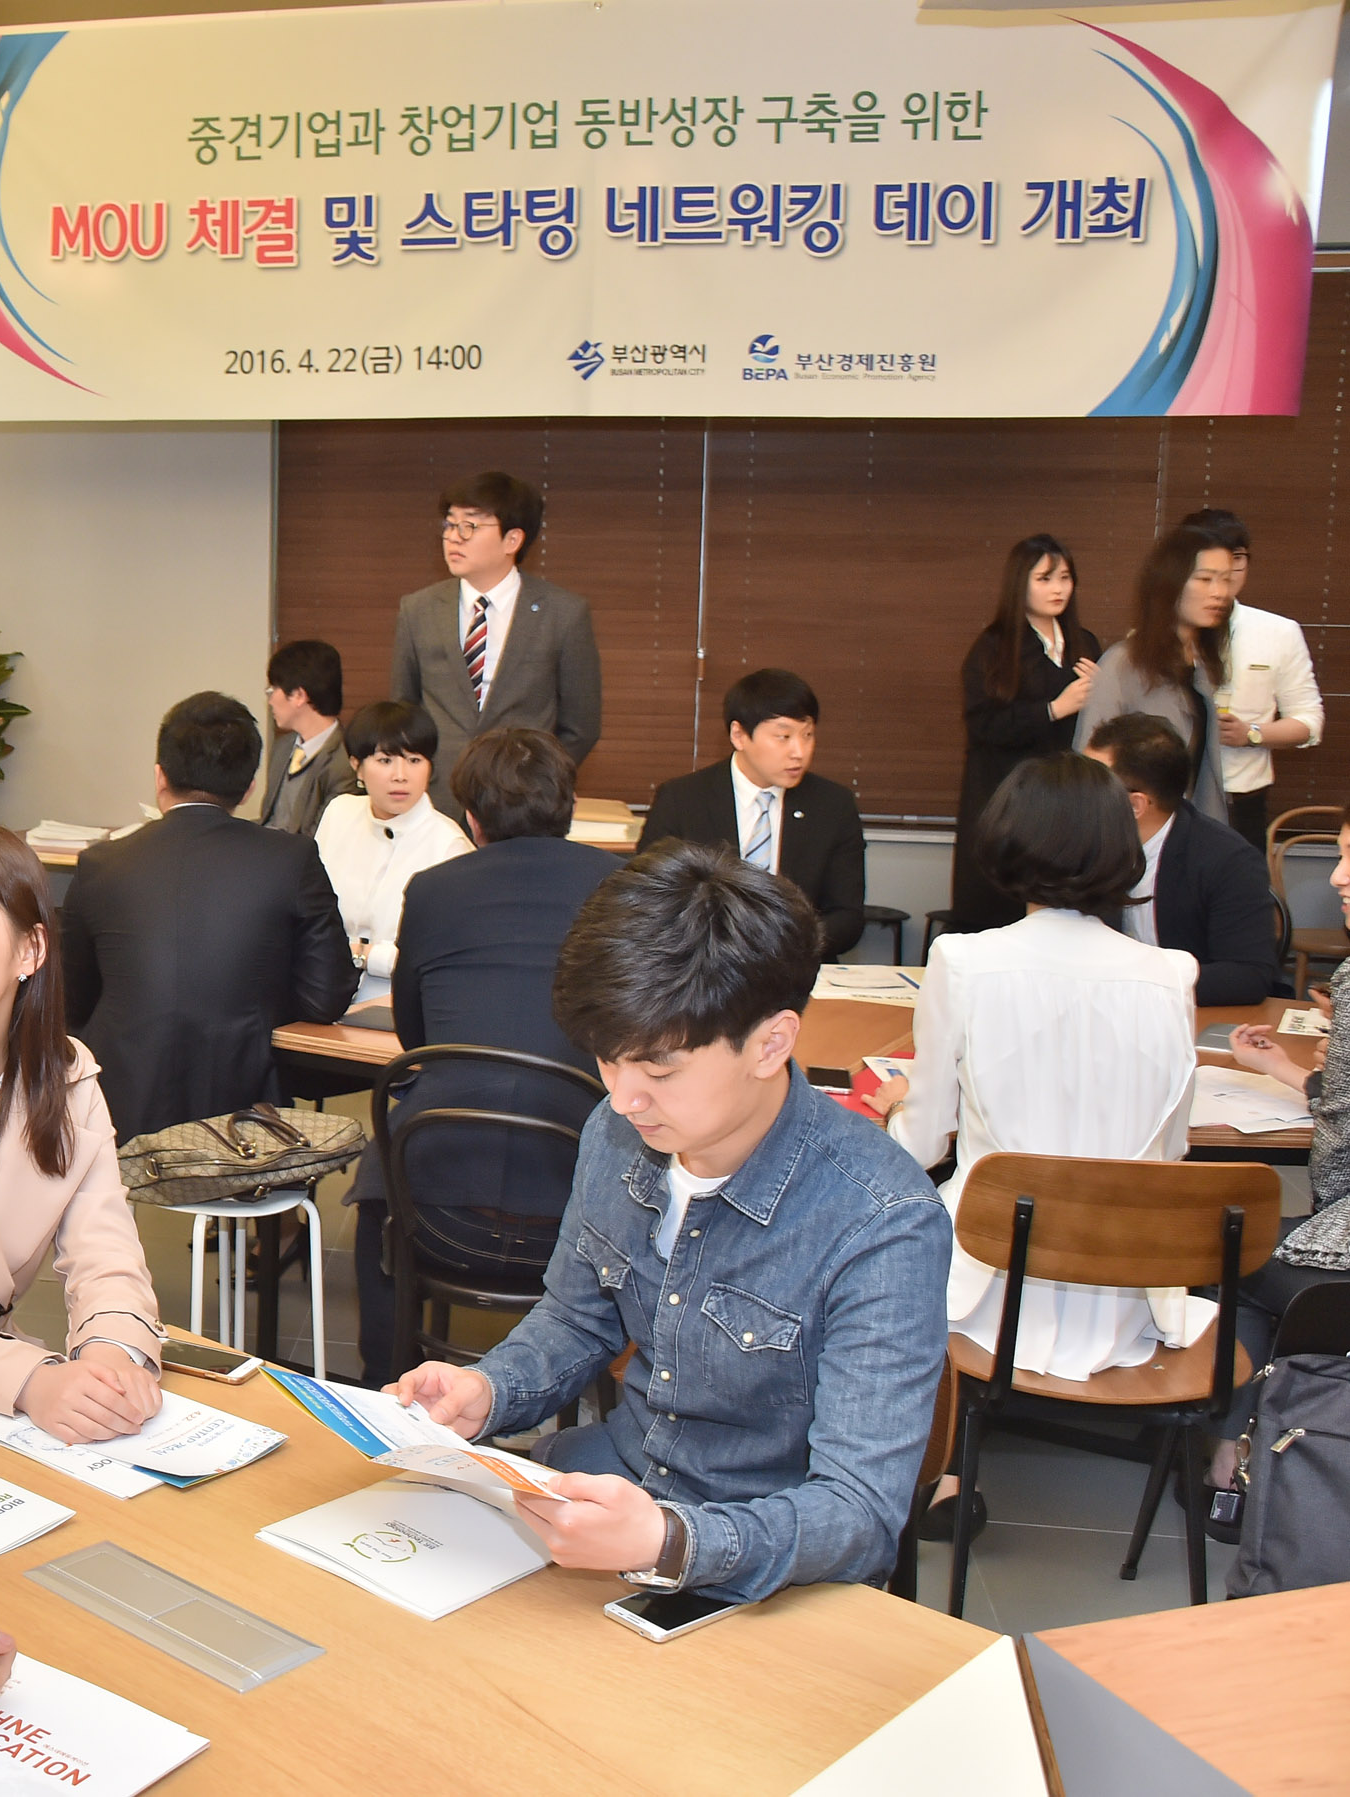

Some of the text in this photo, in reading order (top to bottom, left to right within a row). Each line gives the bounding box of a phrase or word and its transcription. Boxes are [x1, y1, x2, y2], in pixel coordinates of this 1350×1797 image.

[188, 89, 989, 166] 중견기업과 창업기업 동반성장 구축을 위한
[49, 176, 1148, 267] MOU 체결 및 스타팅 네트워킹 데이 개최
[224, 347, 292, 376] 2016.
[327, 344, 402, 375] 22(금)
[413, 344, 483, 372] 14:00
[611, 344, 707, 364] 부산광역시
[795, 352, 937, 373] 부산경제진흥원
[742, 366, 789, 381] BEPA
